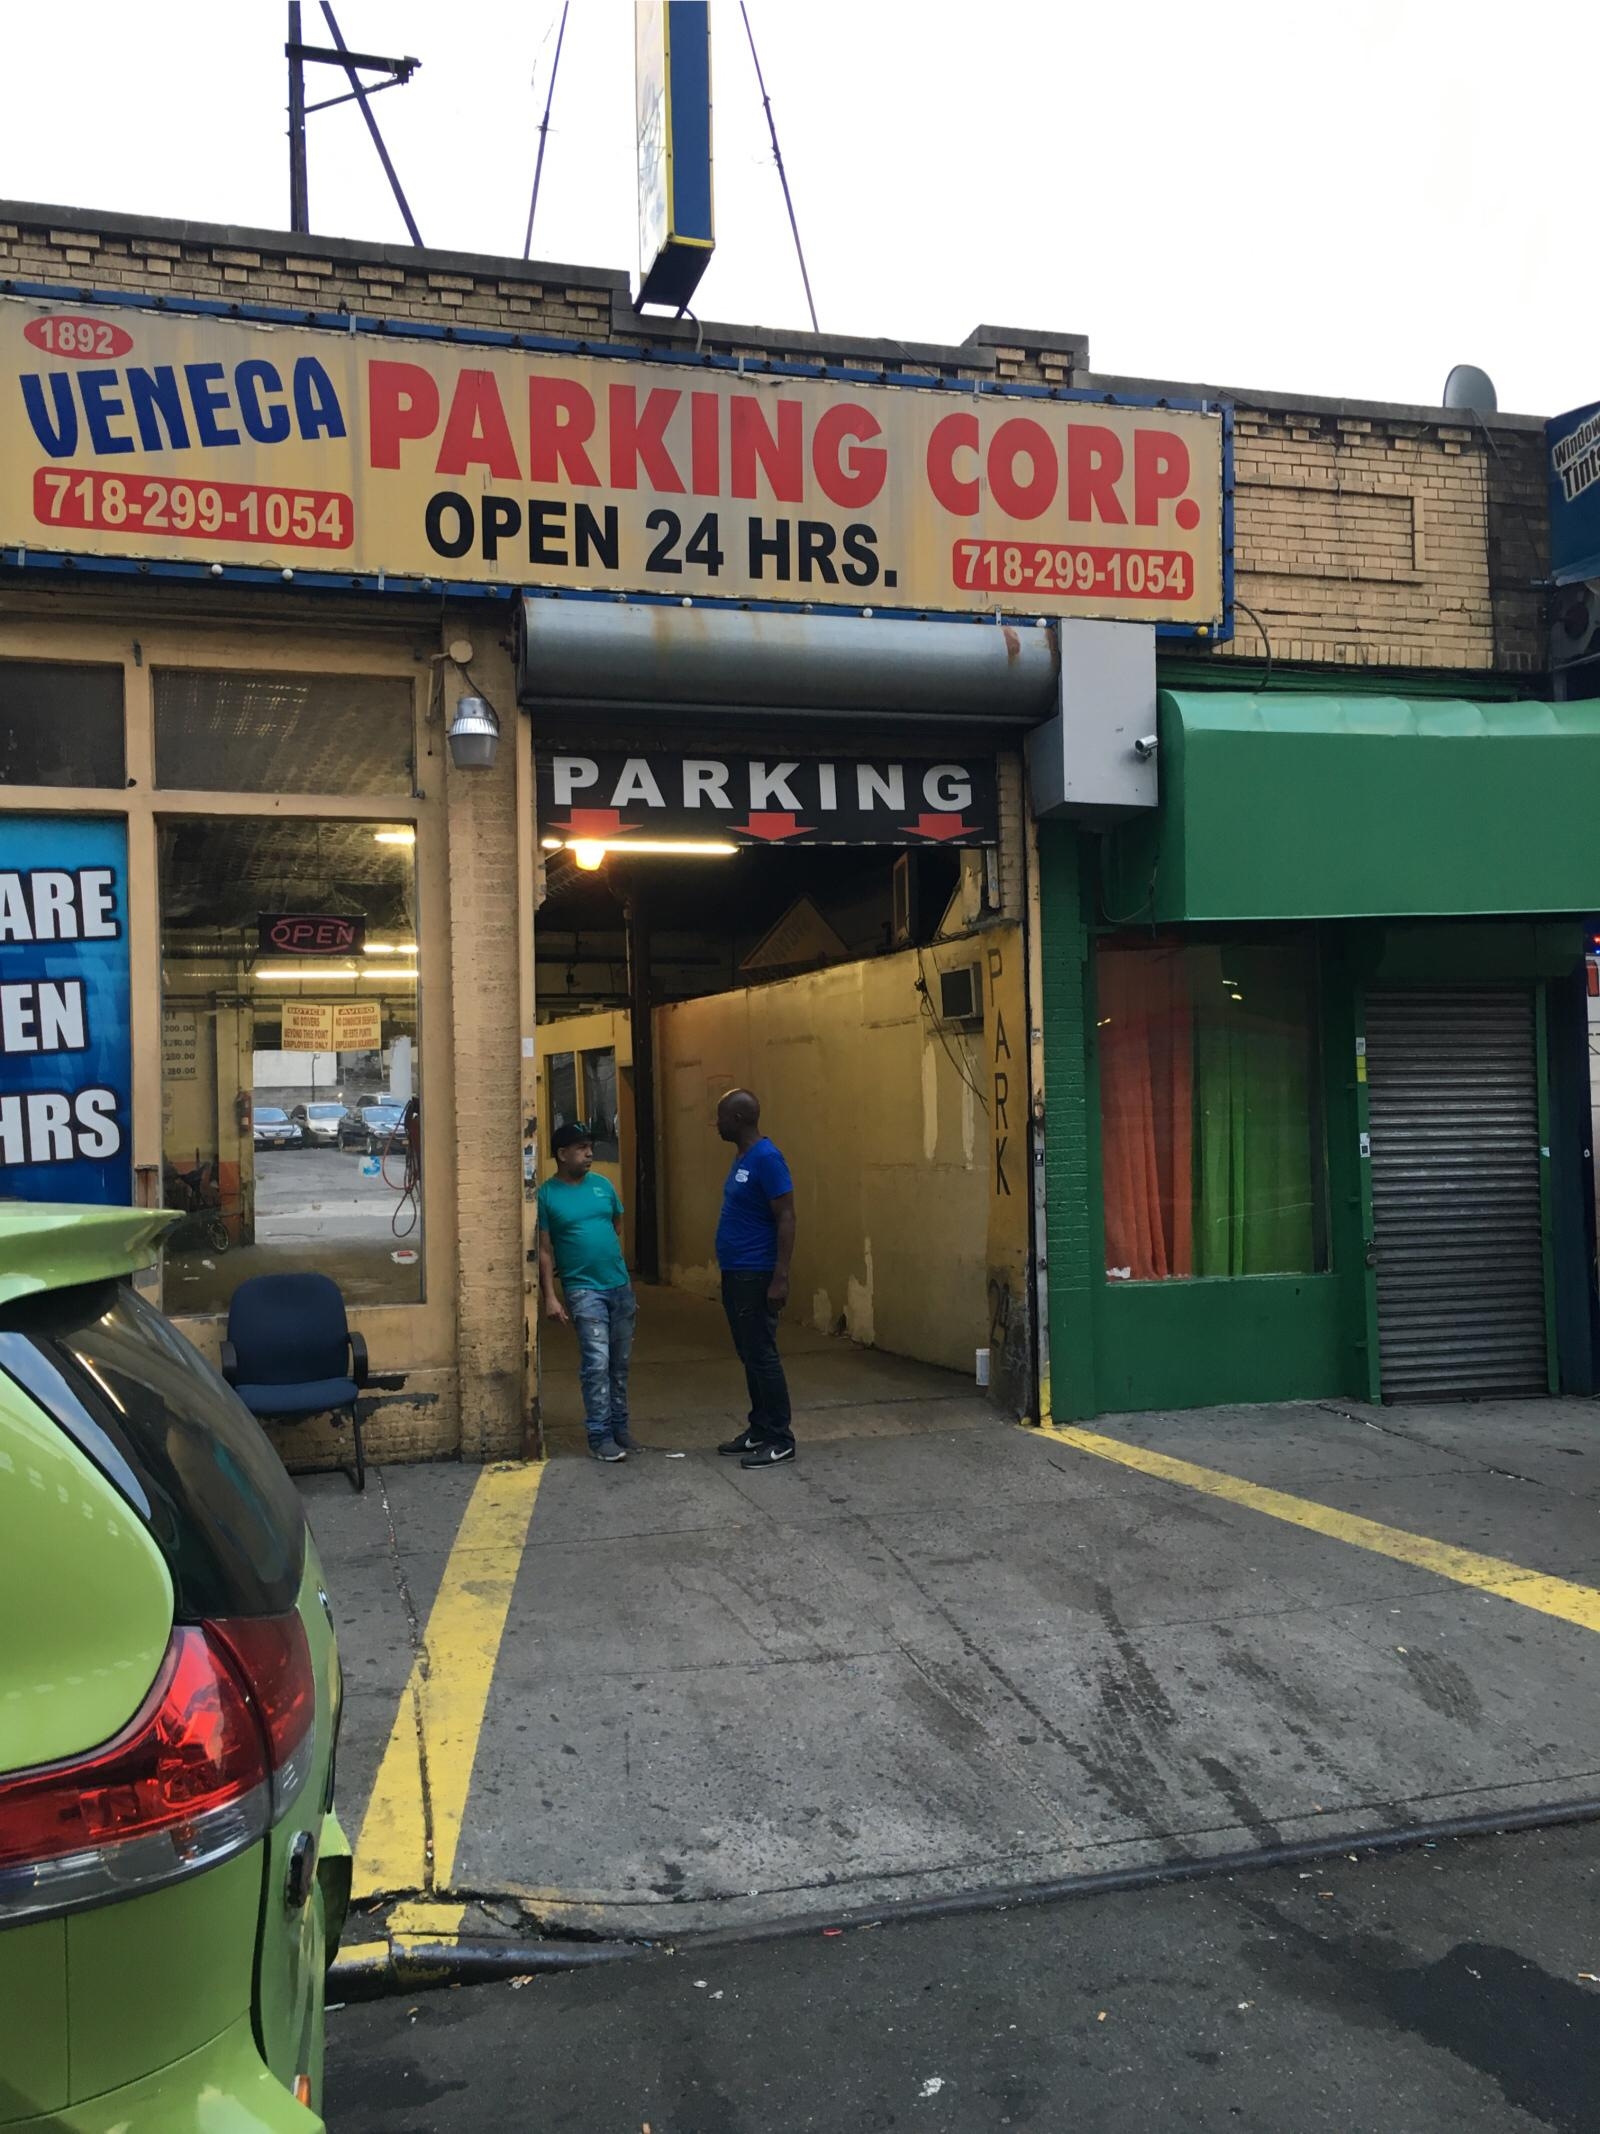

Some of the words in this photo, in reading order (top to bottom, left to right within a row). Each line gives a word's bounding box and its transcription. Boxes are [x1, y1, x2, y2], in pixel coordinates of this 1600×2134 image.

[40, 319, 114, 355] 1892
[20, 357, 347, 458] VENECA
[368, 360, 889, 510] PARKING
[926, 411, 1201, 532] CORP.
[44, 473, 344, 542] 718-299-1054
[424, 490, 619, 570] OPEN
[645, 508, 724, 577] 24
[748, 515, 898, 588] HRS.
[961, 544, 1186, 594] 718-299-1054
[552, 756, 973, 812] PARKING
[270, 925, 355, 944] OPEN
[0, 981, 85, 1052] EN
[288, 1007, 325, 1016] NOTICE
[340, 1007, 374, 1015] AVISO
